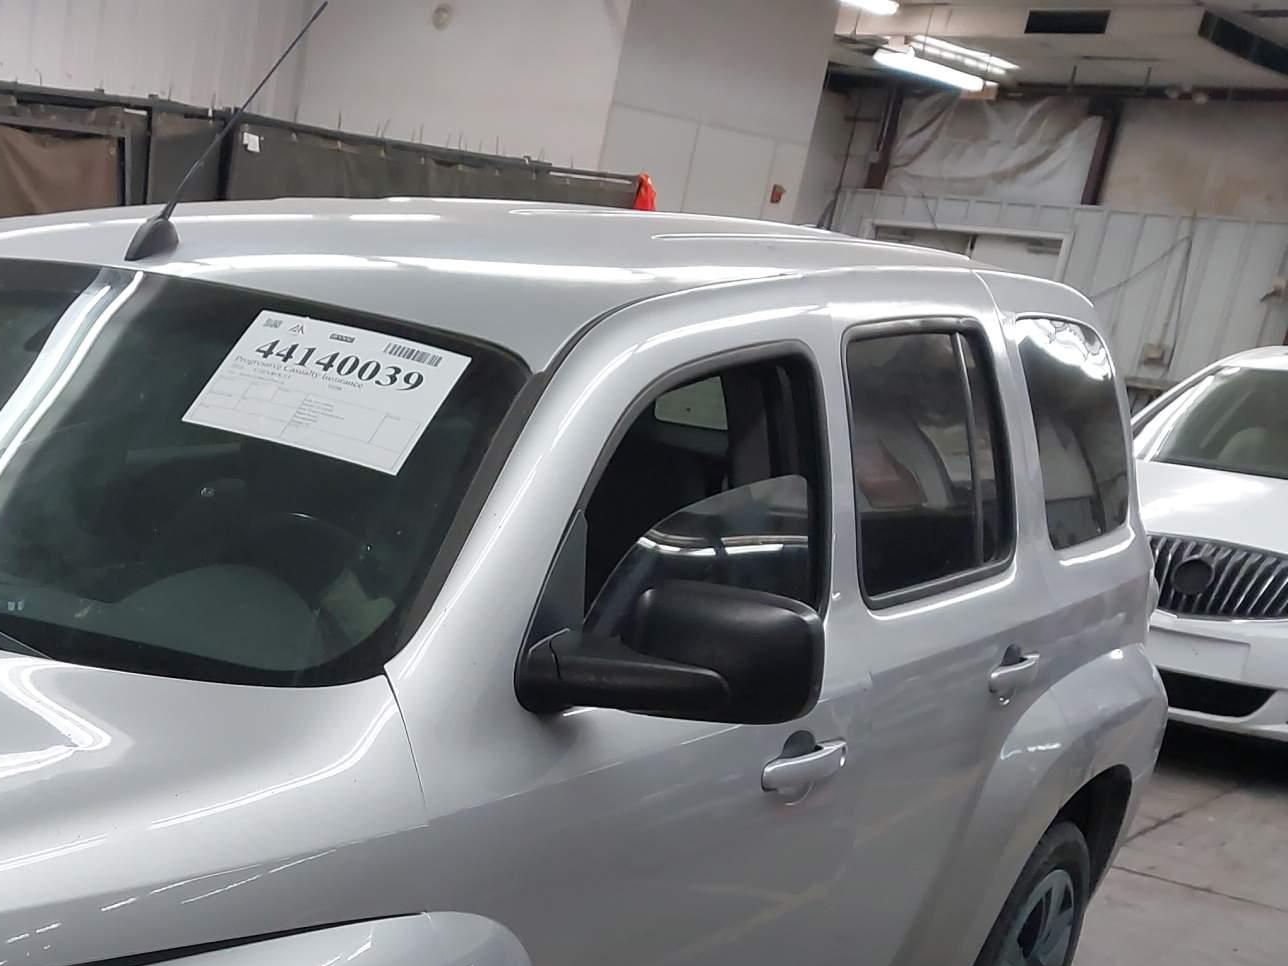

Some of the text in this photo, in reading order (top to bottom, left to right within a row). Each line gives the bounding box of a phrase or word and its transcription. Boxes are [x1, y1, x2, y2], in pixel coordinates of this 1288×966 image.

[255, 339, 424, 391] 44140039
[283, 365, 319, 379] Casualty
[321, 372, 365, 389] Insurance
